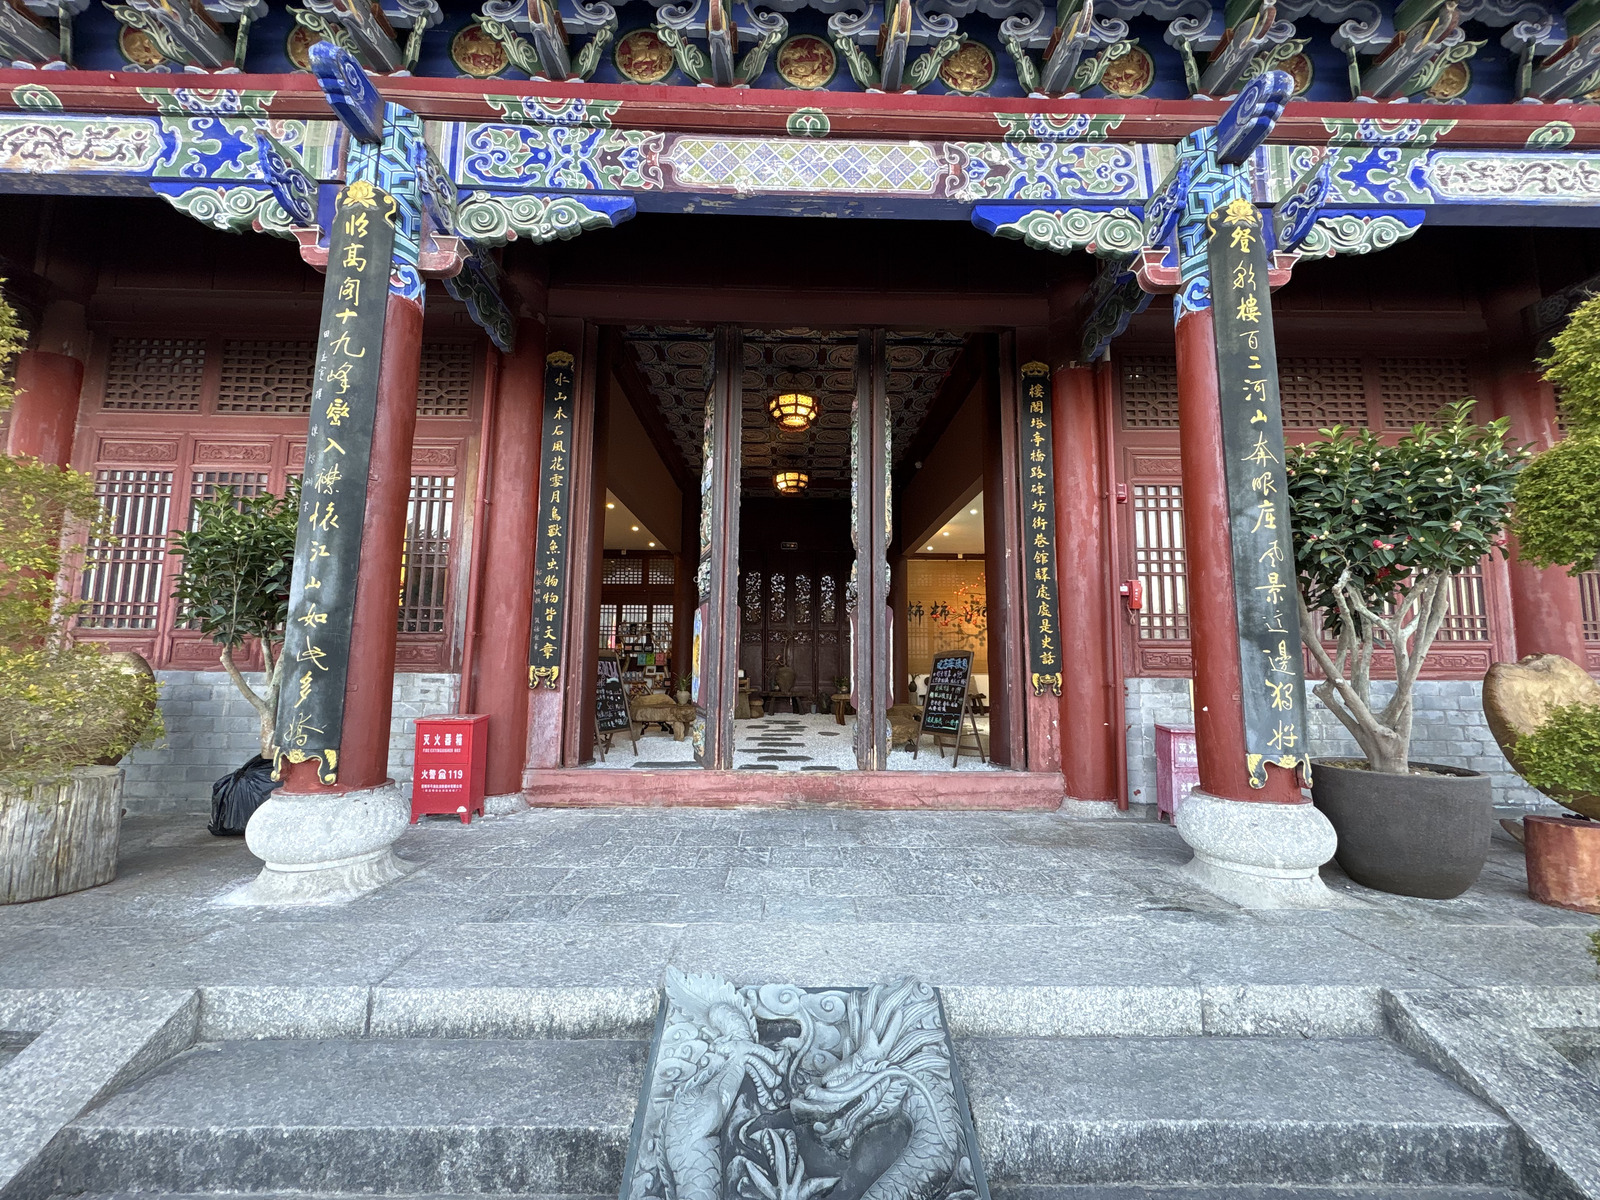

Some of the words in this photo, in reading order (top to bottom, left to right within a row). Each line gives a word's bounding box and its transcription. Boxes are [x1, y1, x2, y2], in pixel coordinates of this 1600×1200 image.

[423, 733, 463, 746] 灭火器箱
[448, 769, 463, 779] 119
